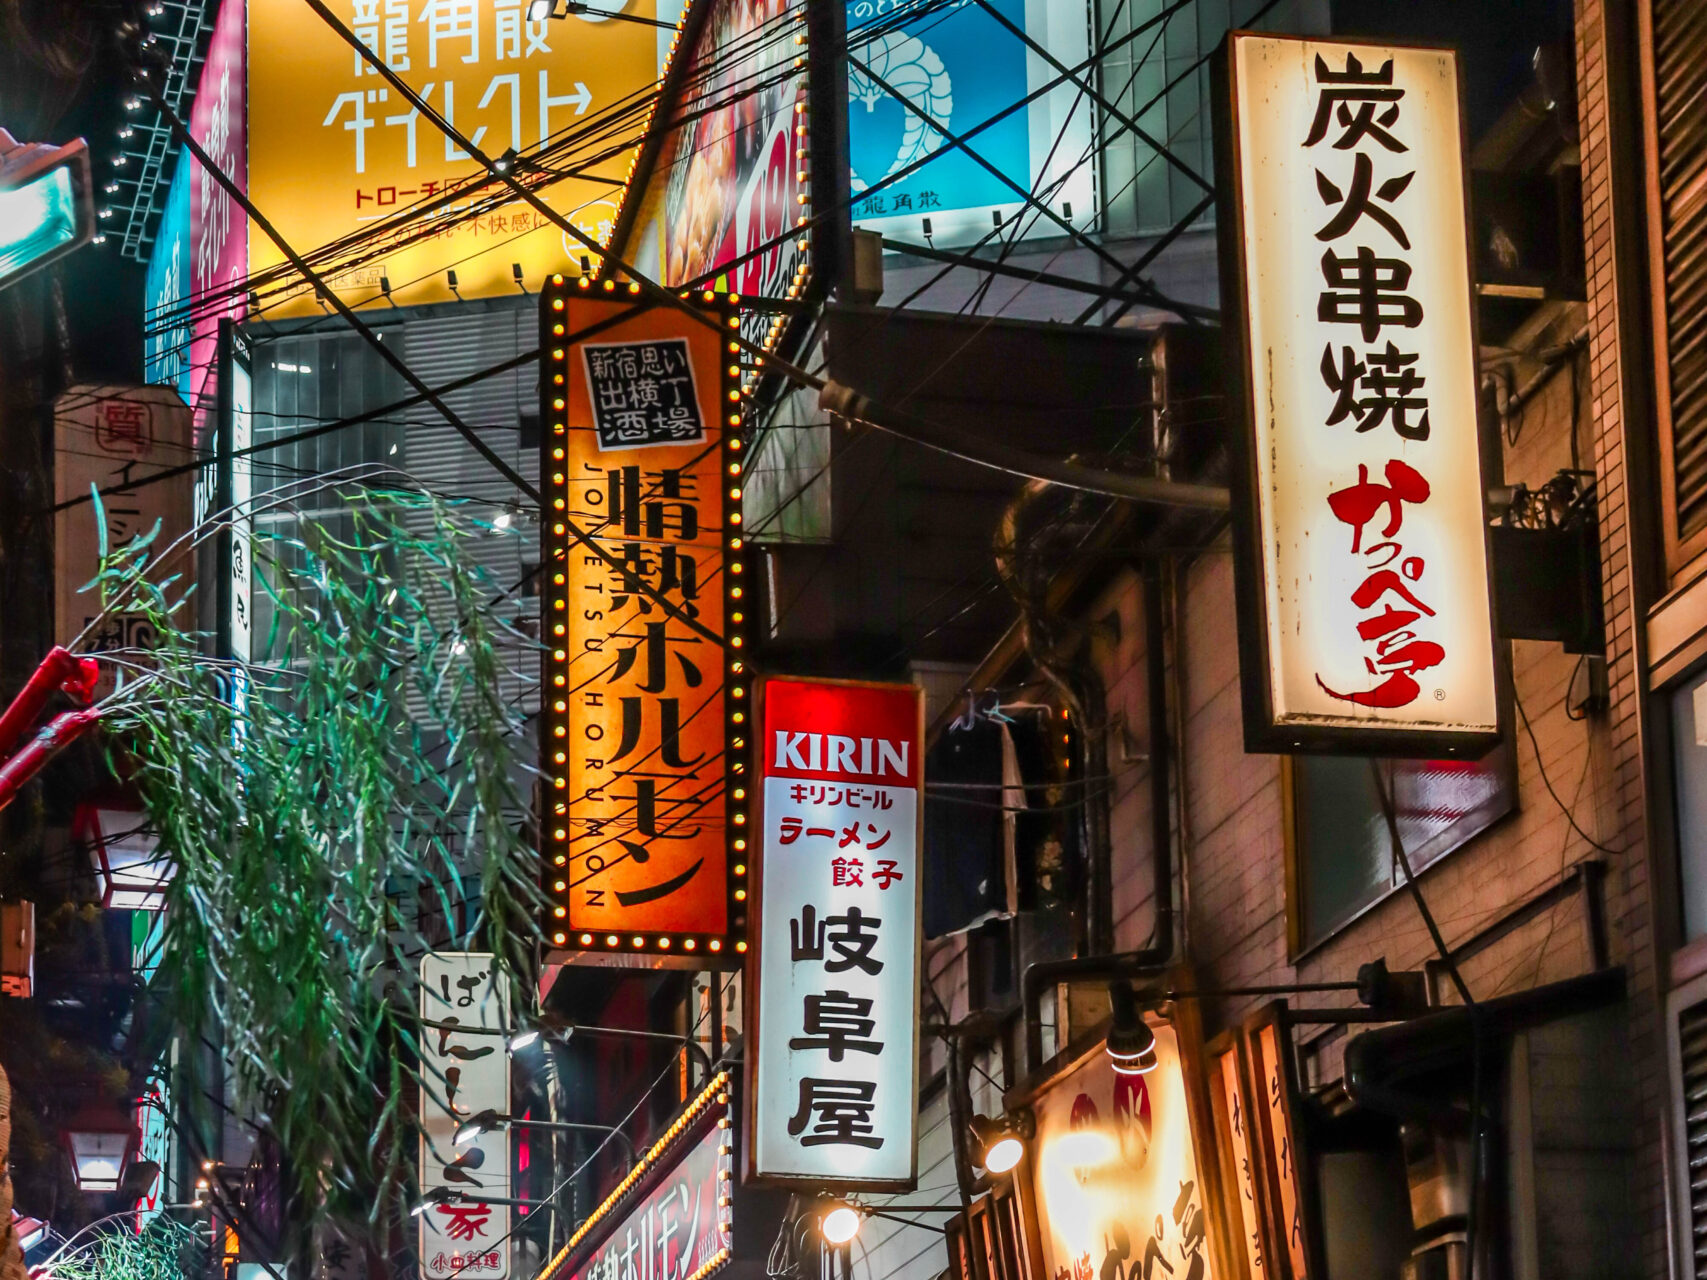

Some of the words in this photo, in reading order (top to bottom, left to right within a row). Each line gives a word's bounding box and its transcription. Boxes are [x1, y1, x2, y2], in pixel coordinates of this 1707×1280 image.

[1302, 51, 1430, 441] 炭火串焼
[591, 347, 686, 380] 新宿思い
[599, 375, 690, 411] 出横丁
[602, 406, 697, 442] 酒場
[607, 465, 706, 908] 情熱ホルモン
[774, 730, 910, 778] KIRIN
[584, 691, 605, 909] HORUMON
[790, 783, 894, 811] キリンビール
[779, 816, 892, 851] ラーメン
[831, 856, 904, 891] 餃子
[786, 903, 883, 1150] 岐阜屋
